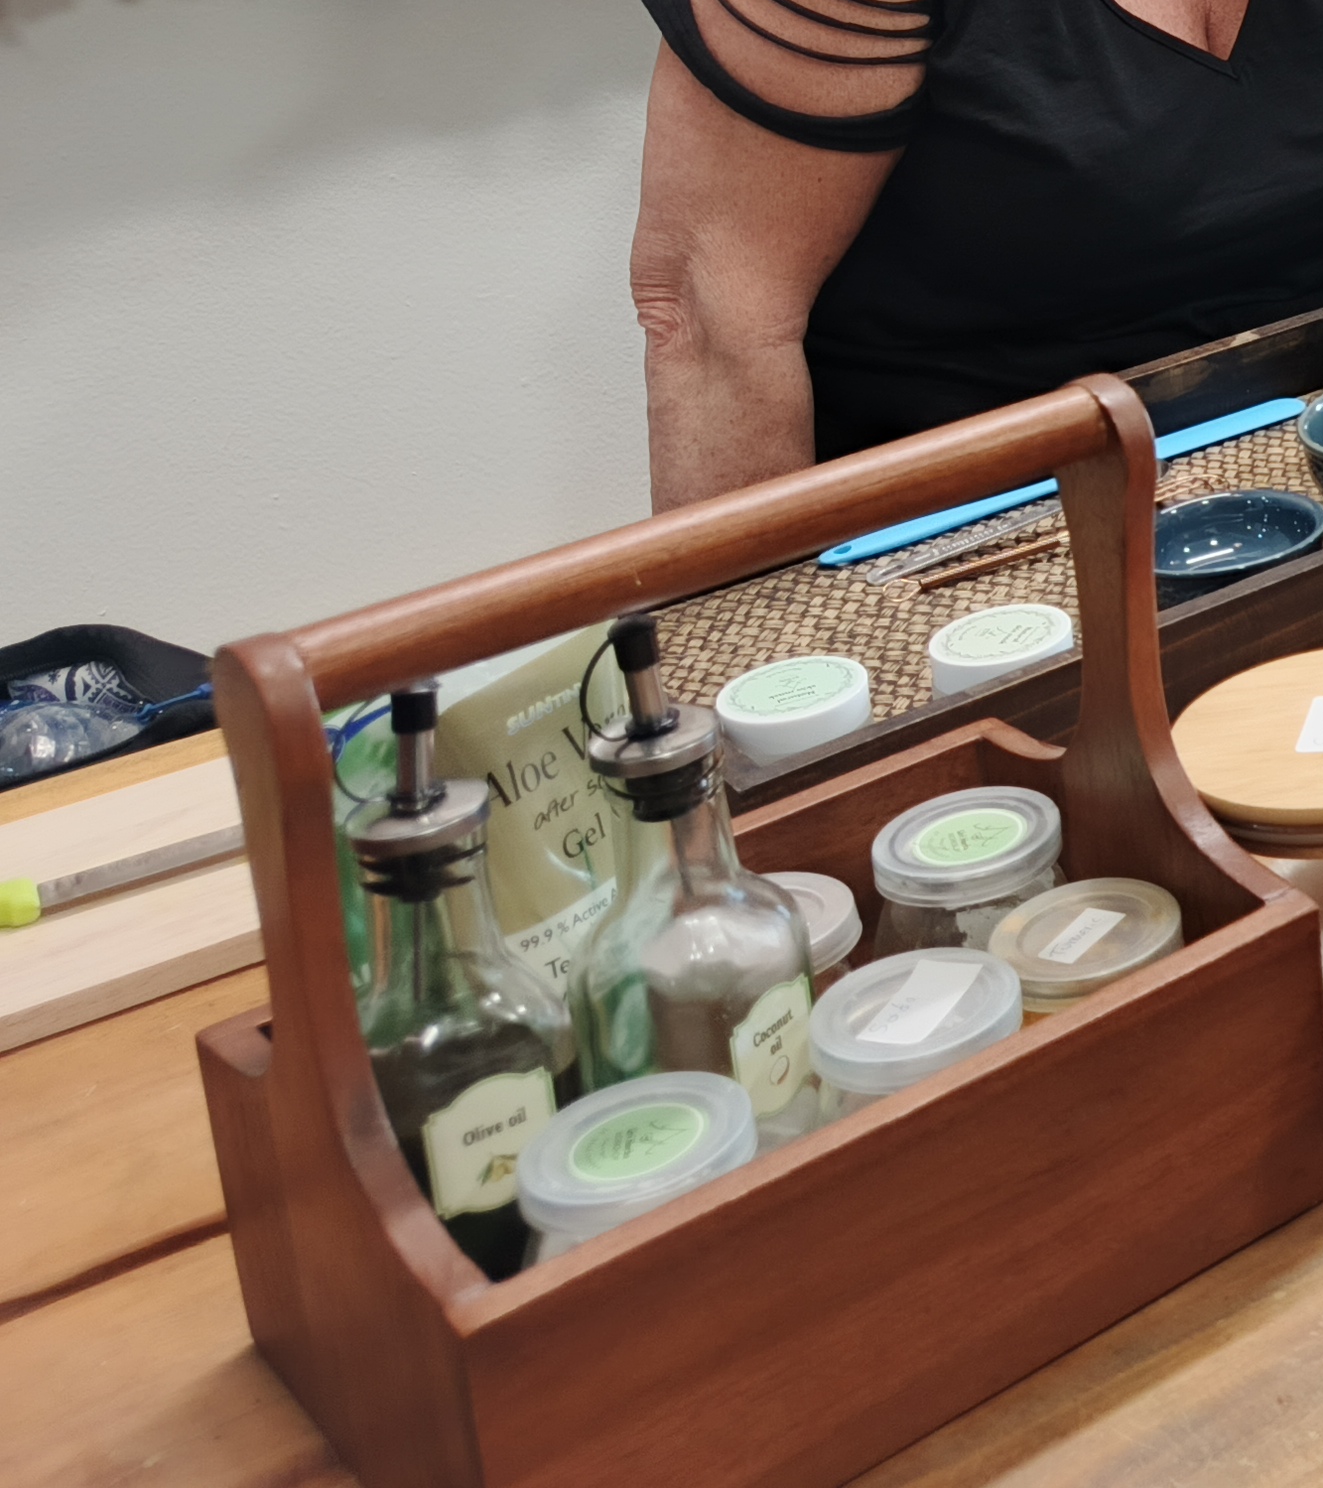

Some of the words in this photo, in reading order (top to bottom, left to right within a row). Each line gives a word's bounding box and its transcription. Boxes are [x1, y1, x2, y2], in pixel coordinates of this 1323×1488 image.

[485, 750, 561, 810] Aloe
[533, 789, 579, 831] after
[562, 812, 606, 859] Gel
[520, 928, 553, 952] 99.9
[572, 897, 608, 928] Active
[753, 1007, 794, 1048] Coconut
[770, 1034, 783, 1056] oil
[462, 1121, 504, 1148] Olive
[508, 1106, 527, 1128] oil
